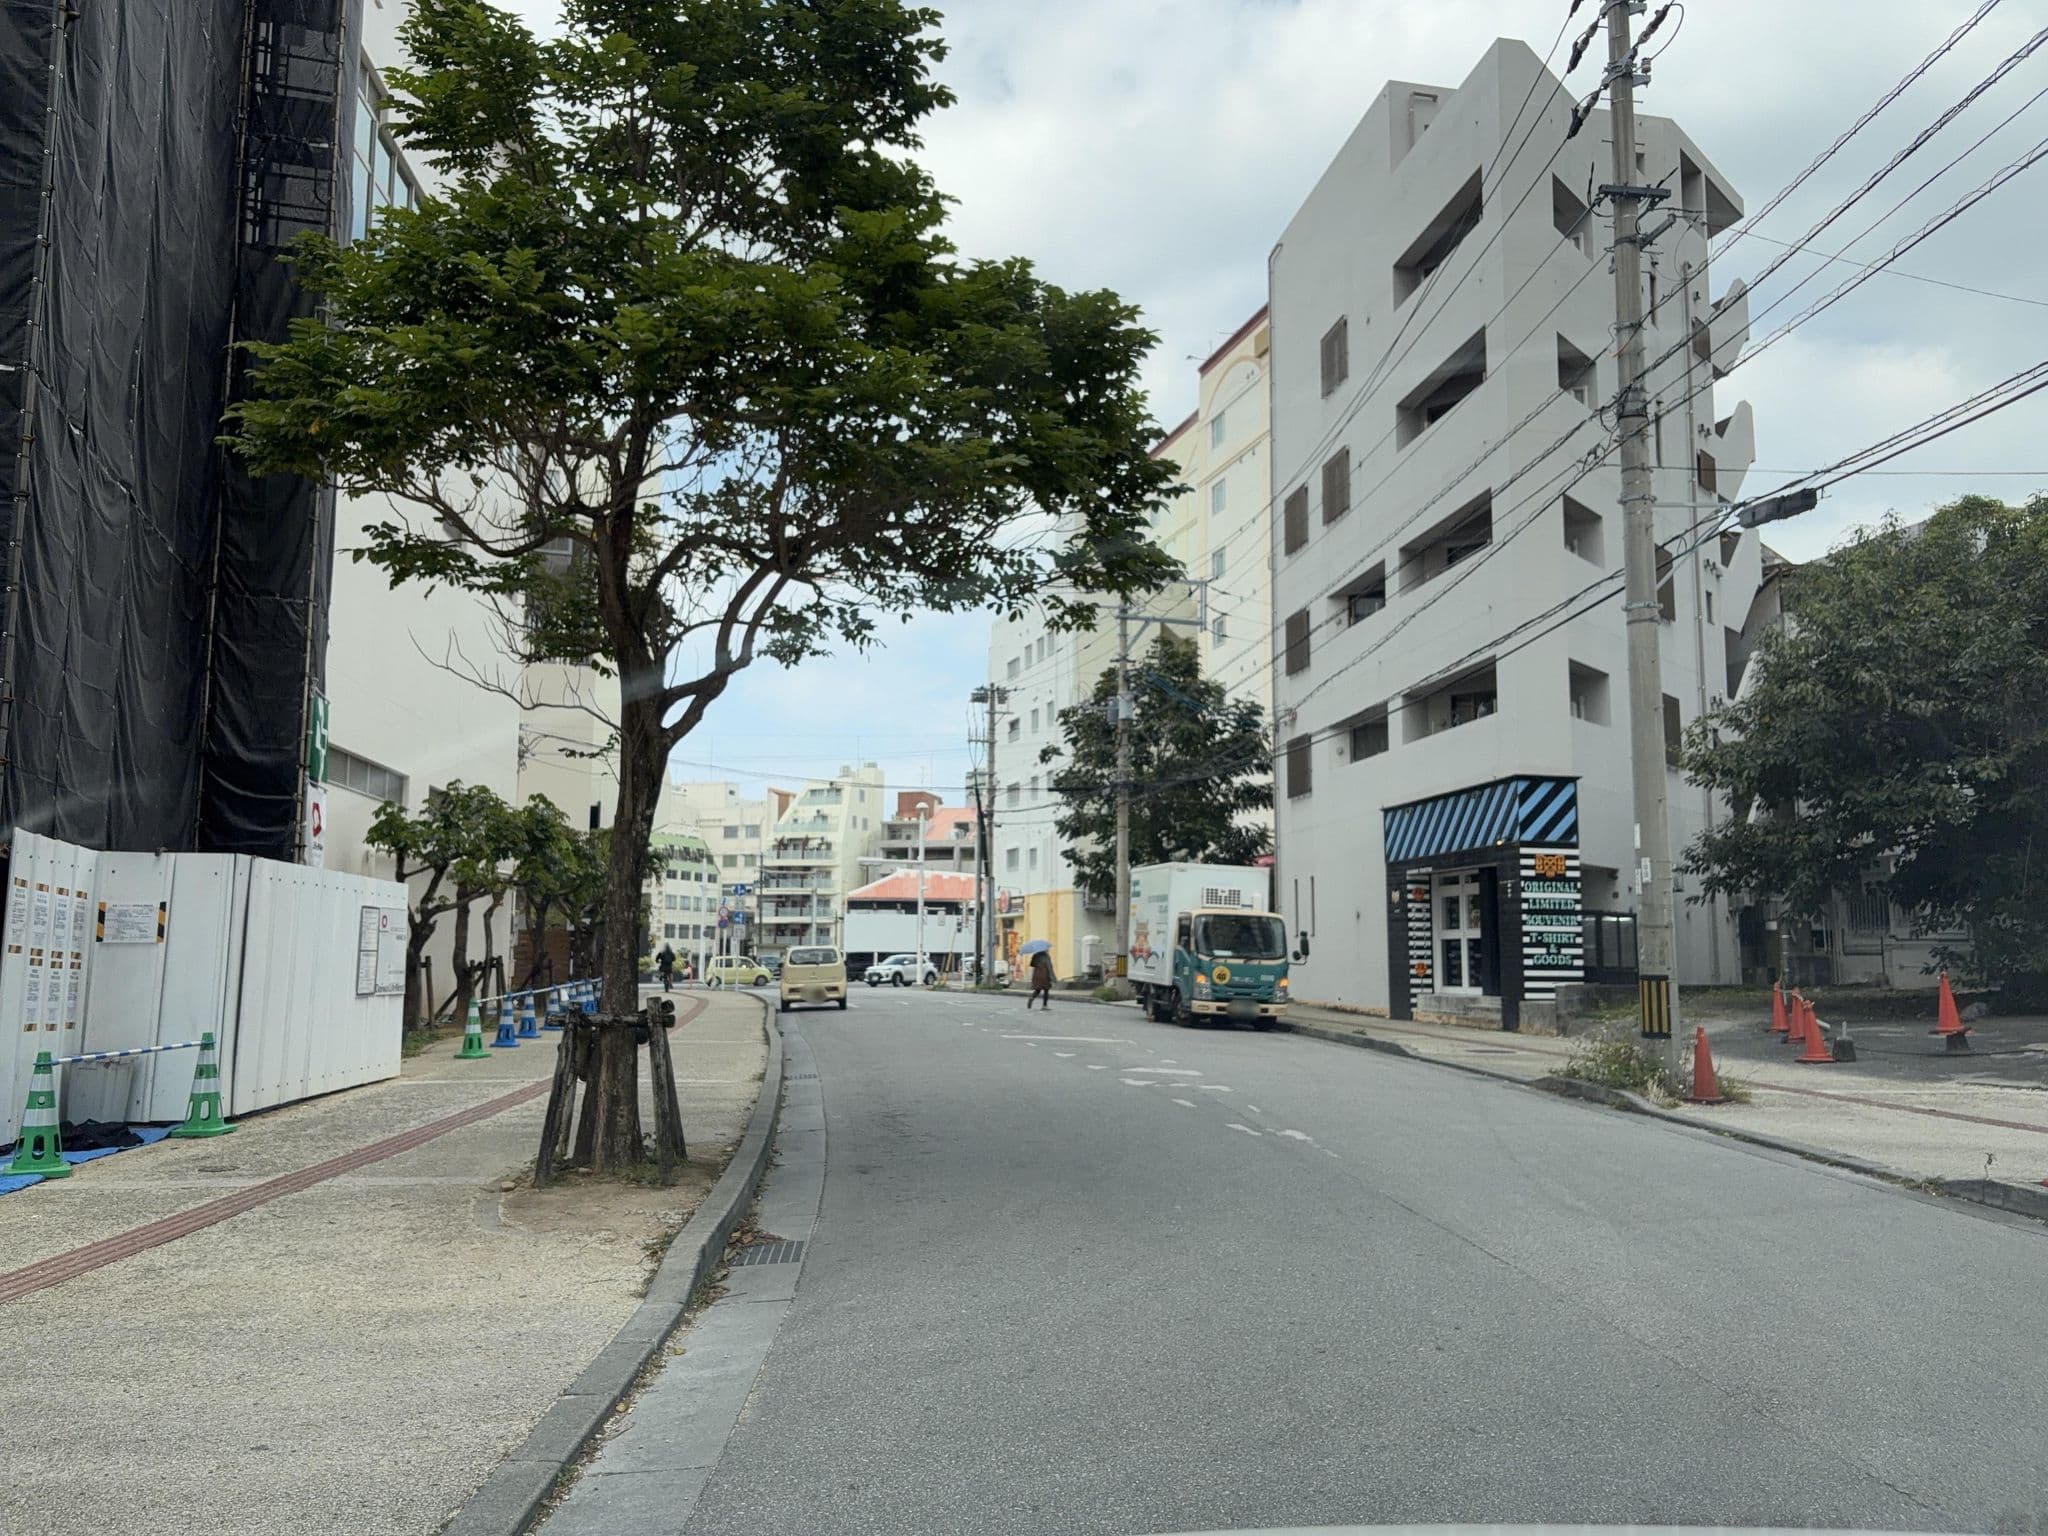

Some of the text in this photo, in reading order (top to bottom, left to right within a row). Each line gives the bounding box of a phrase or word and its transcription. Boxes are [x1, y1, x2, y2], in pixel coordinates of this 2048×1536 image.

[1524, 881, 1577, 893] ORIGINAL
[1529, 899, 1575, 910] LIMITED
[1525, 914, 1578, 926] SOUVENIR
[1530, 933, 1576, 944] T-SHIRT
[1549, 943, 1558, 953] &
[1533, 955, 1572, 966] GOODS
